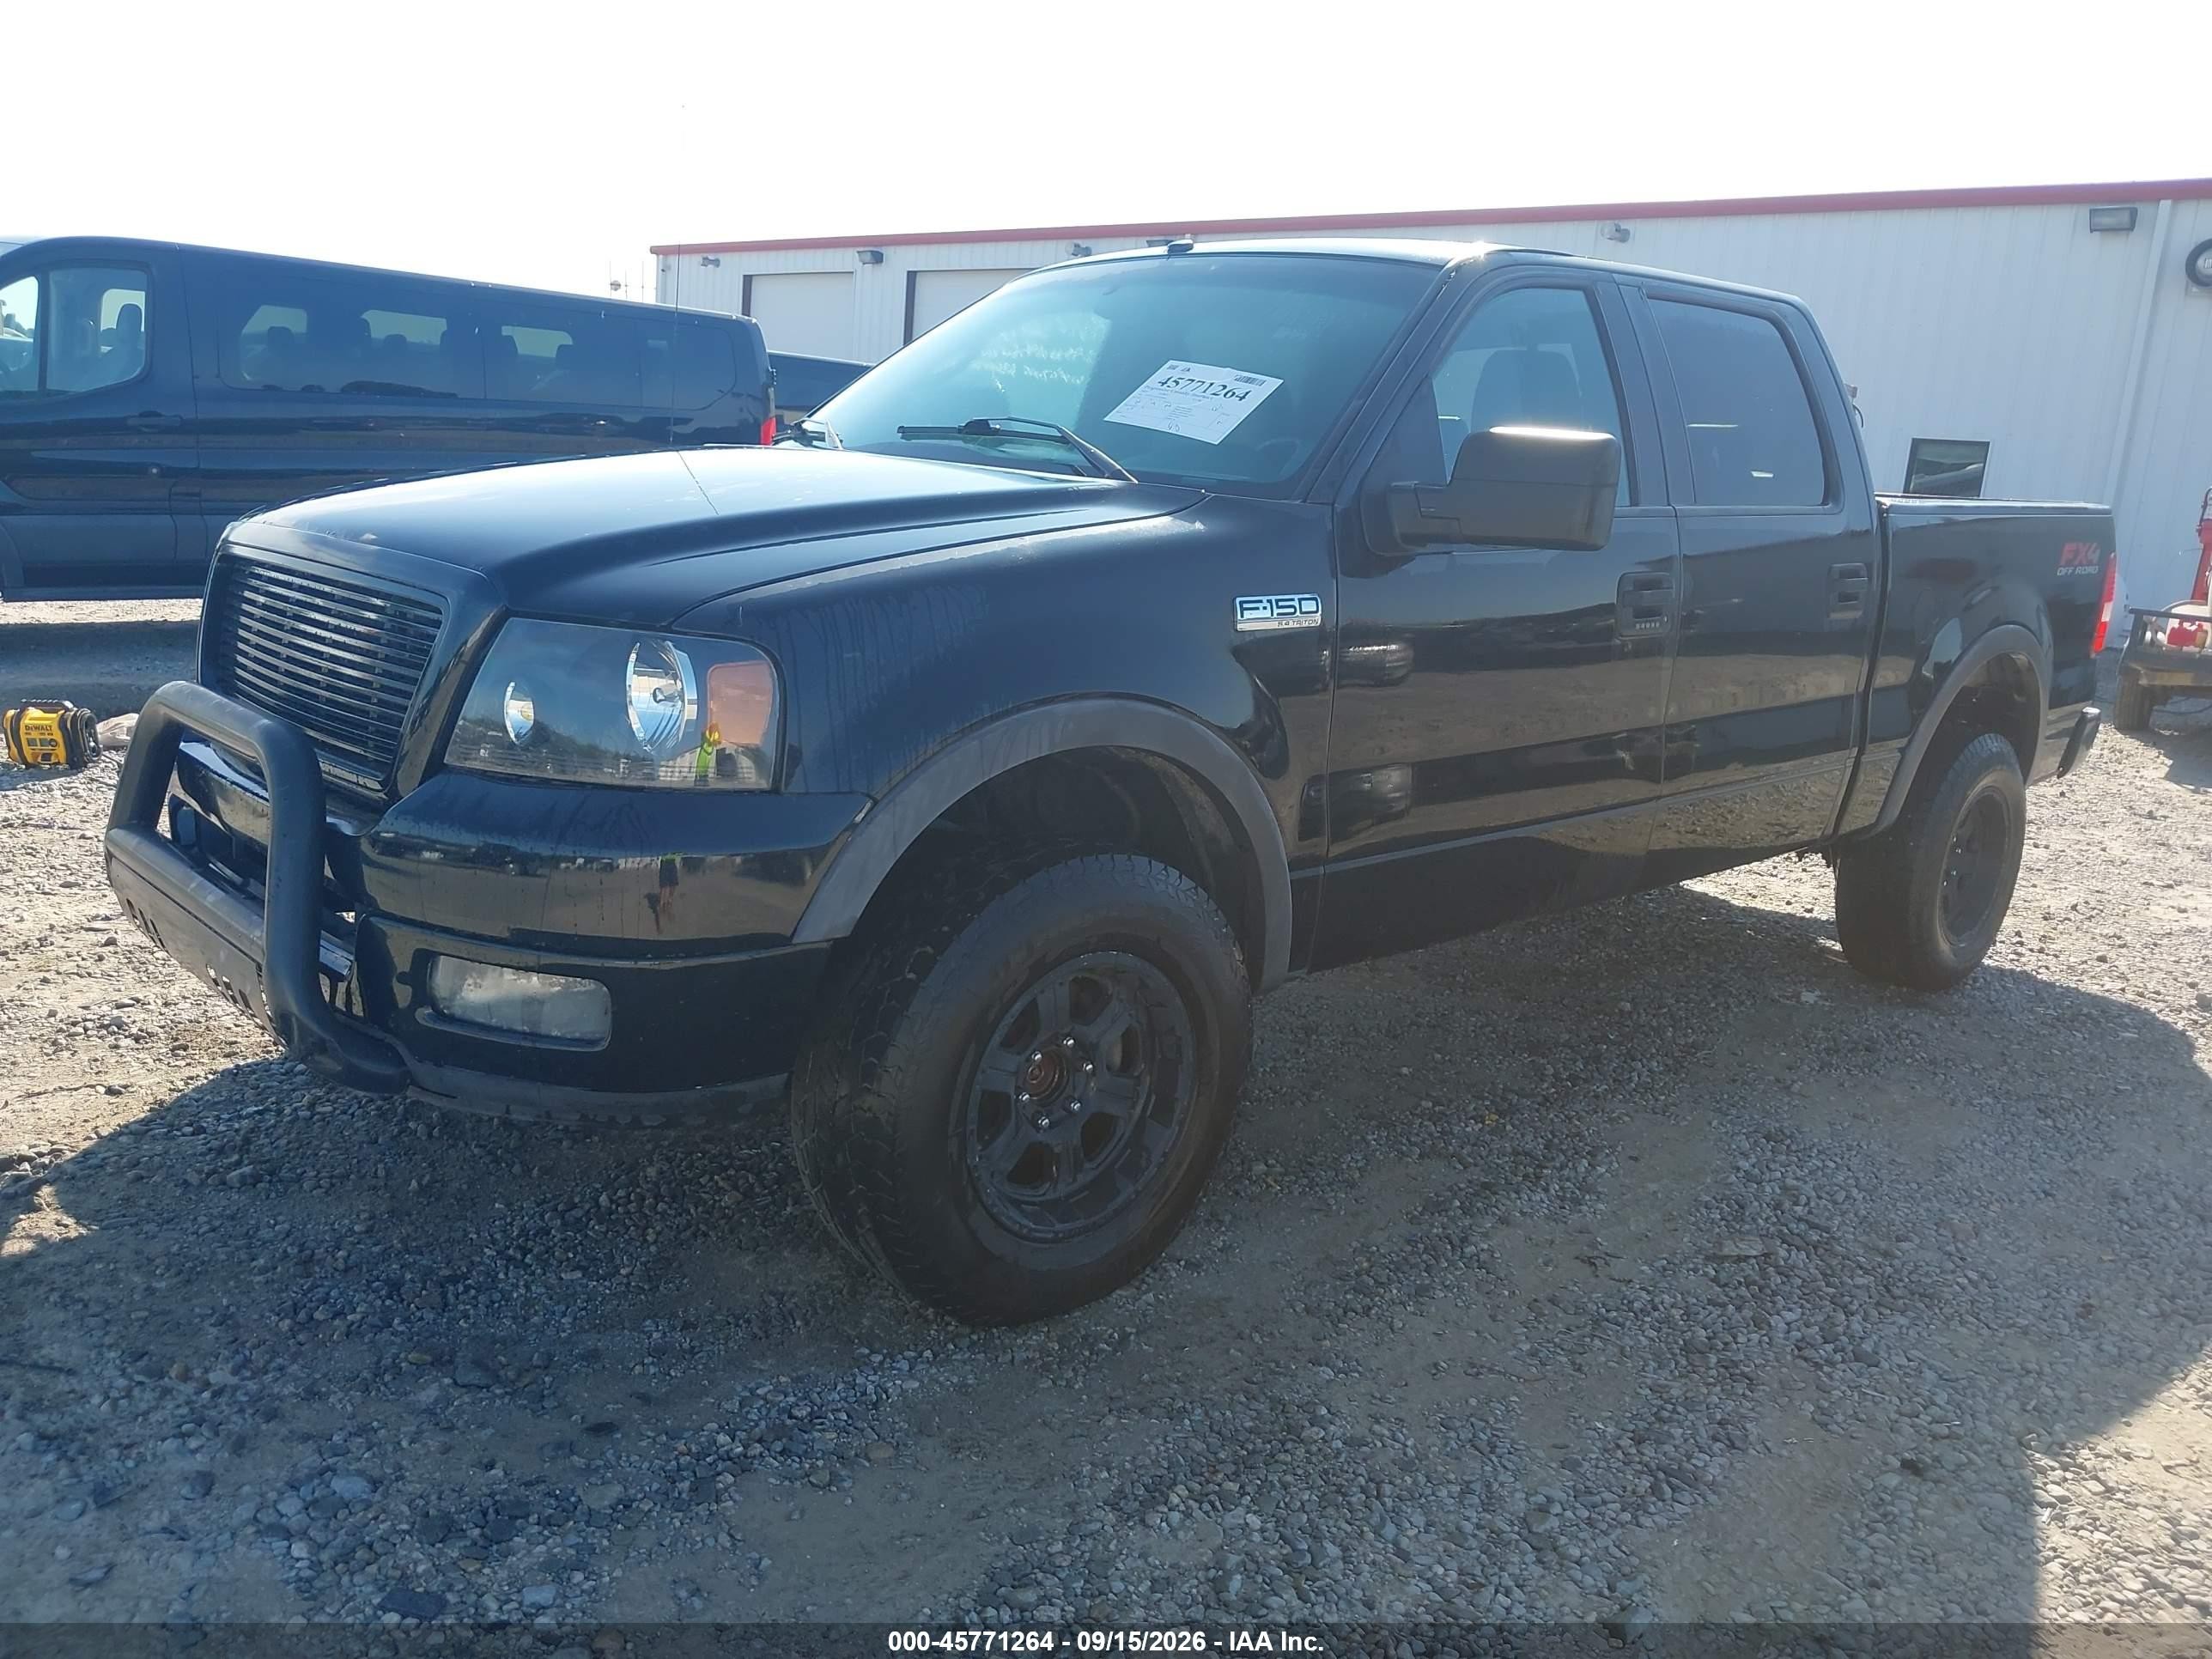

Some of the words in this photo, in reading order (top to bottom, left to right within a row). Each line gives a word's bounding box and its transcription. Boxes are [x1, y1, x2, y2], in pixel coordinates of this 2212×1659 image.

[1158, 375, 1252, 401] 45771264
[2060, 542, 2101, 565] FX4
[2057, 567, 2074, 575] OFF
[2075, 566, 2099, 575] ROAD
